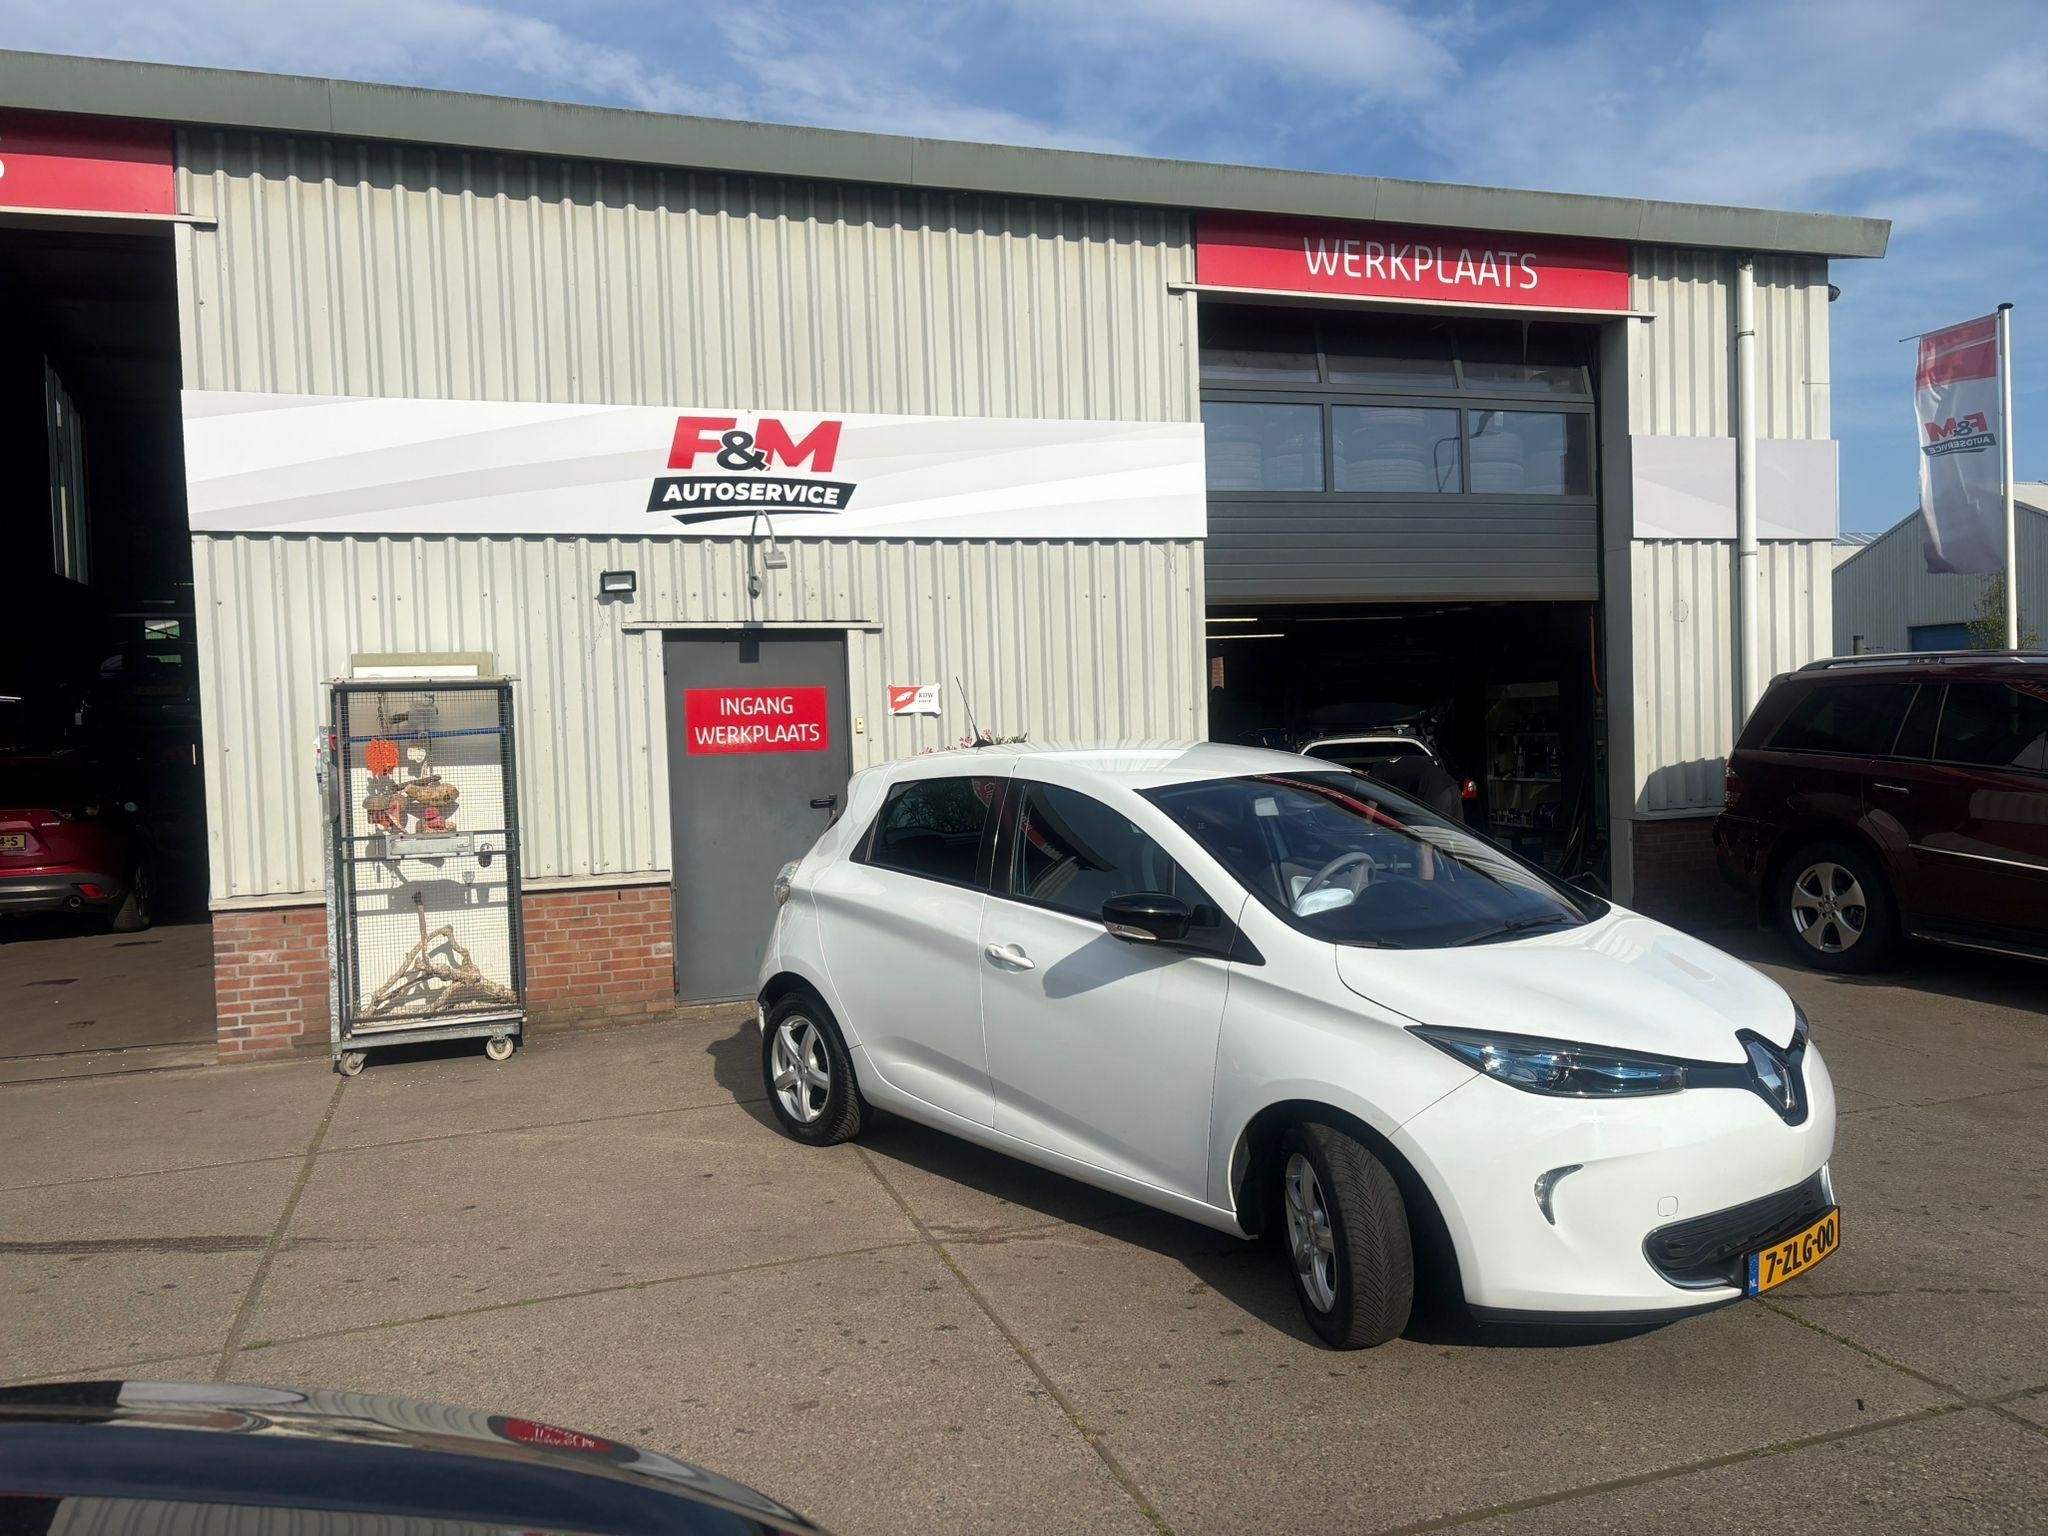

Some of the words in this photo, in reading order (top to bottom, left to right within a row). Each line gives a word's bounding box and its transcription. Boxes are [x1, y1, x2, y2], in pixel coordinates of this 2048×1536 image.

[1303, 236, 1538, 290] WERKPLAATS
[666, 415, 843, 473] F&M
[662, 483, 841, 506] AUTOSERVICE
[720, 696, 794, 716] INGANG
[694, 723, 820, 745] WERKPLAATS
[1765, 1218, 1835, 1284] 7-ZLG-00
